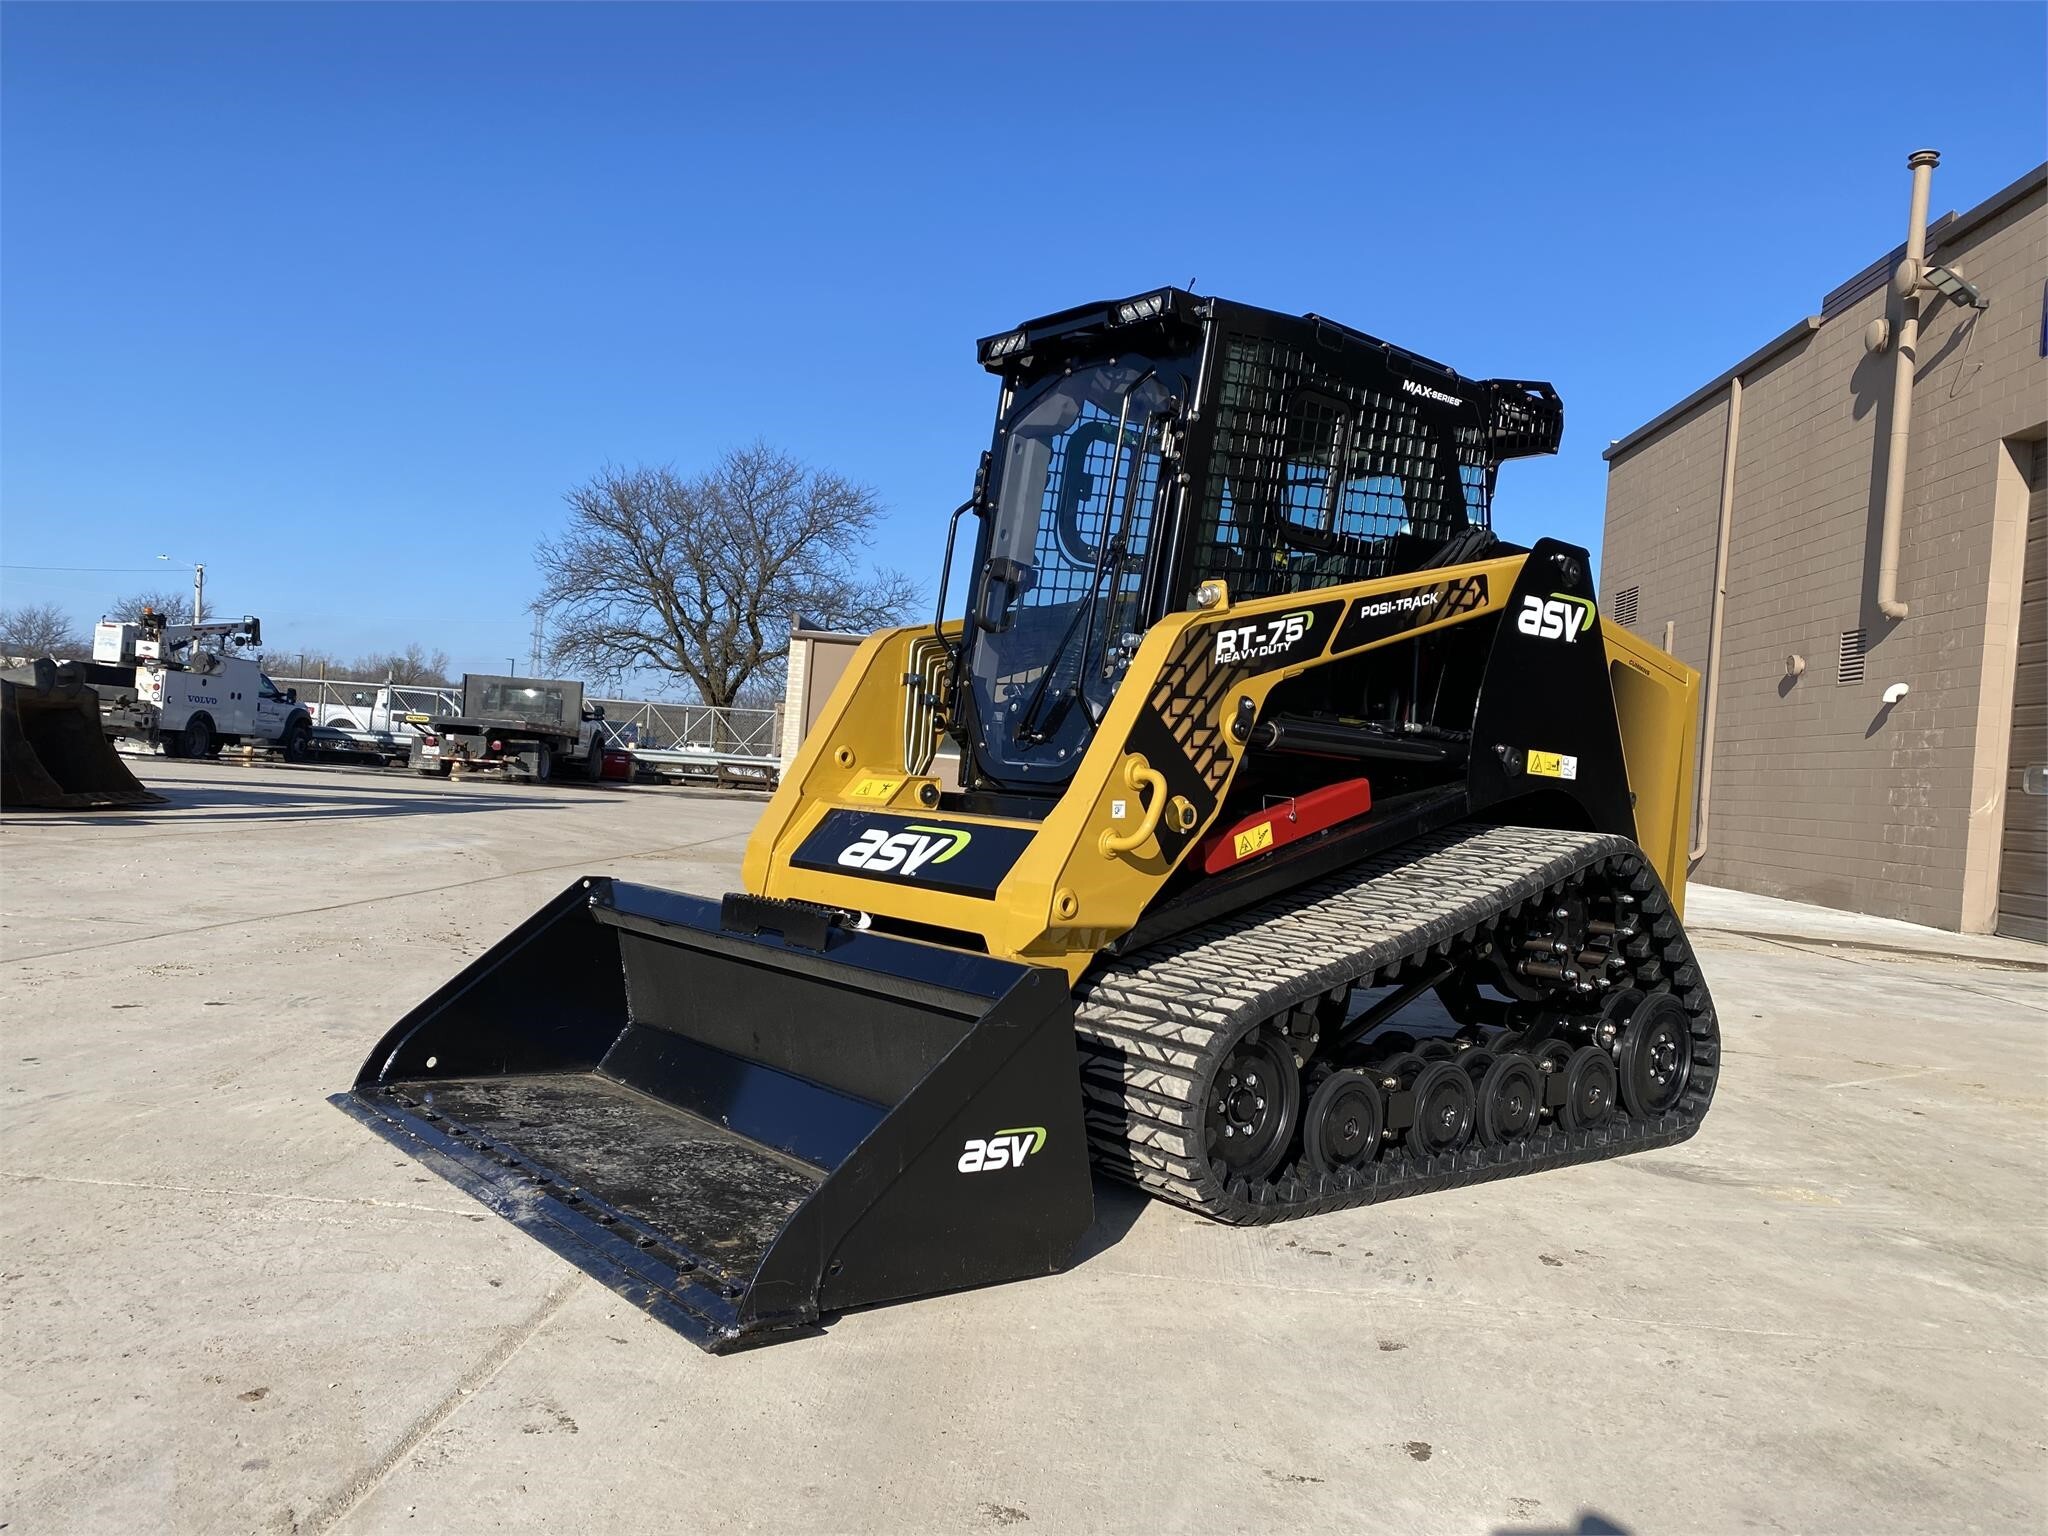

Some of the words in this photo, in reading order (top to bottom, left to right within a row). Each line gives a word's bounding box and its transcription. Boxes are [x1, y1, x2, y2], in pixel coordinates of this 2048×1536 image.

[1361, 592, 1438, 618] POSI-TRACK
[1518, 595, 1586, 643] asv
[1215, 648, 1259, 664] HEAVY
[1259, 641, 1291, 655] DUTY
[1216, 616, 1304, 655] RT-75
[187, 695, 218, 705] VOLVO
[837, 828, 953, 876] asv
[957, 1134, 1035, 1173] asv
